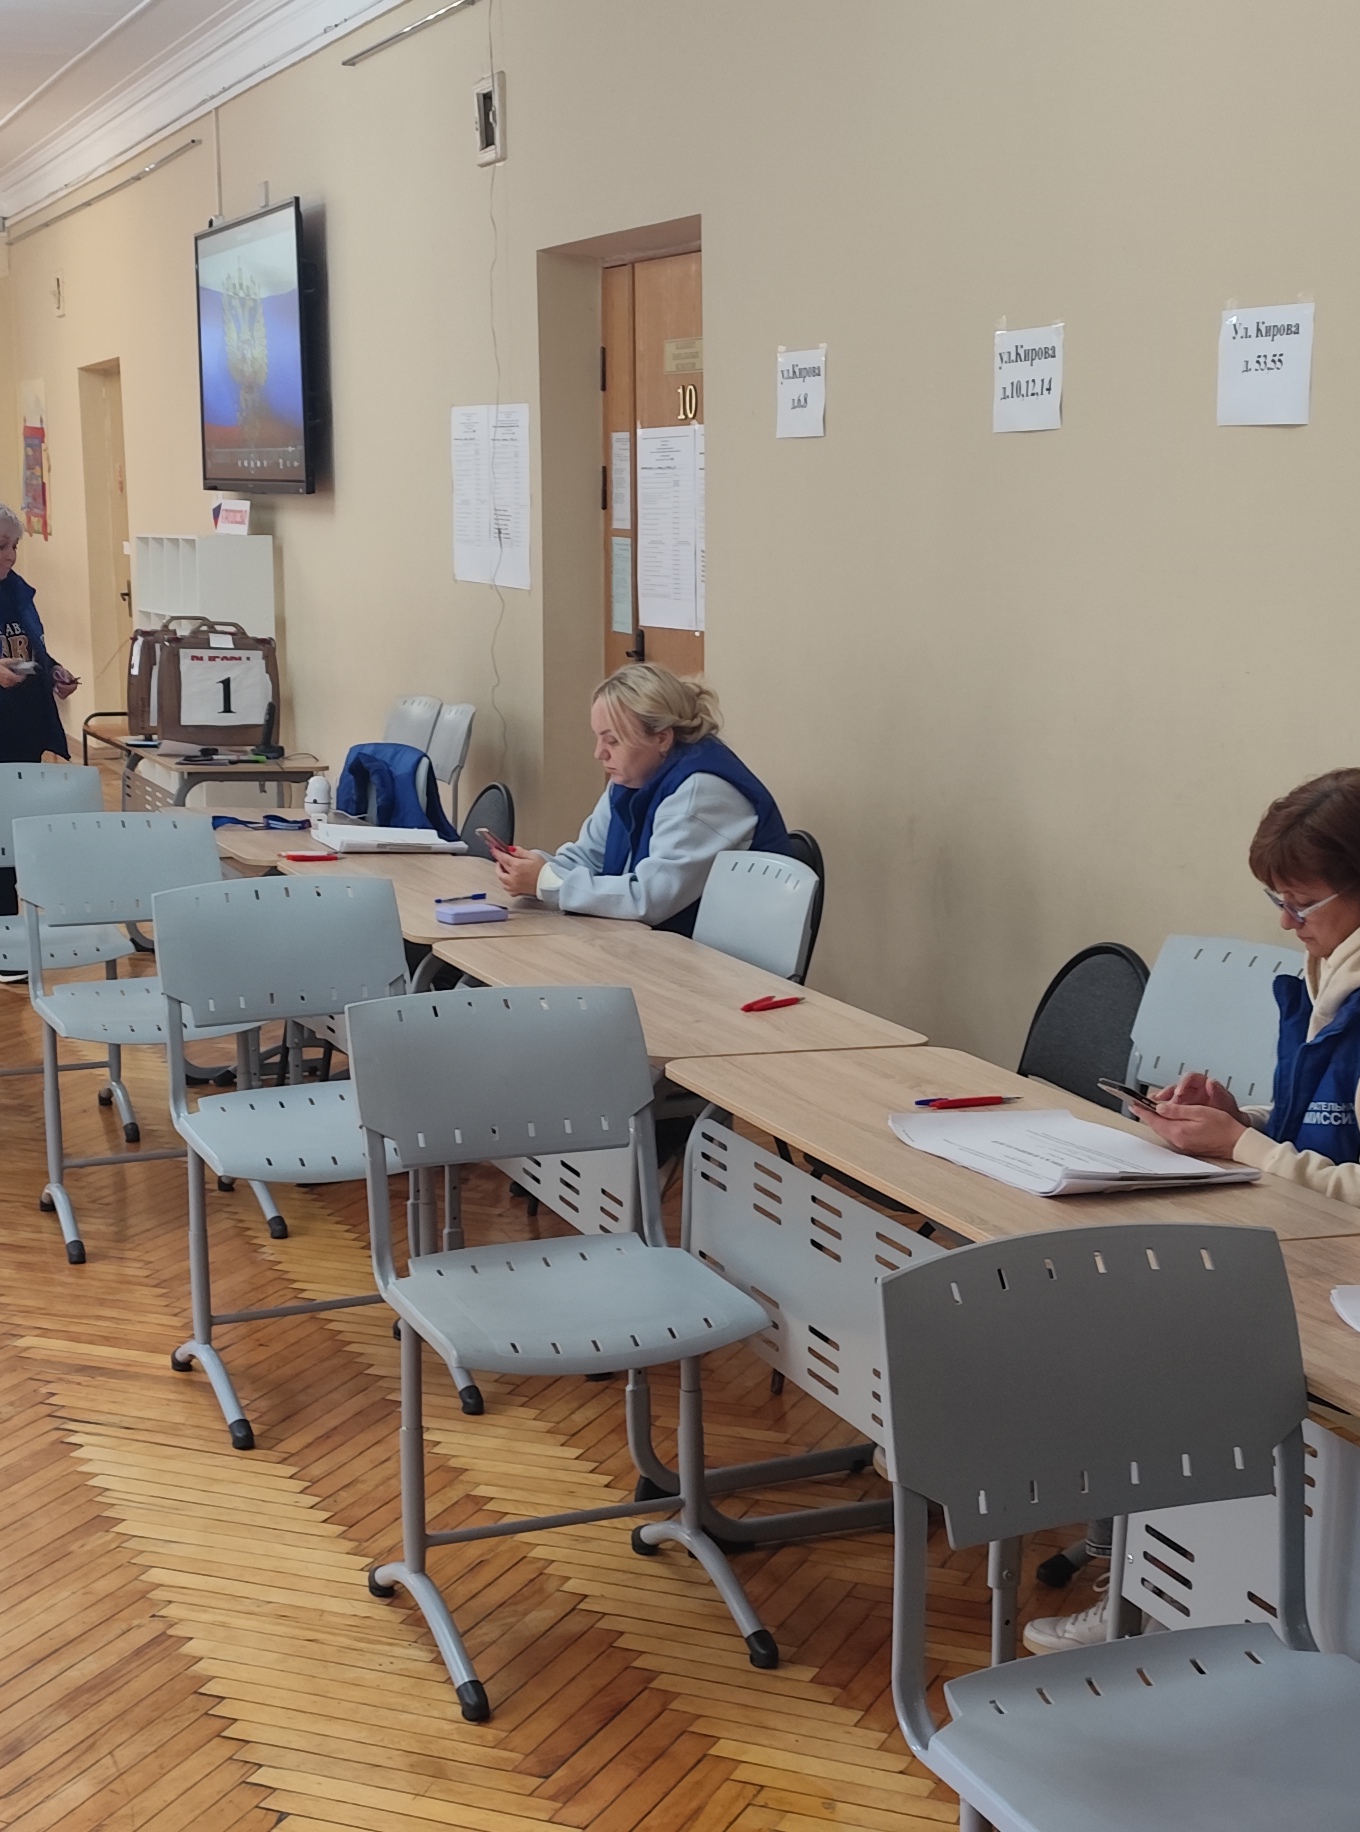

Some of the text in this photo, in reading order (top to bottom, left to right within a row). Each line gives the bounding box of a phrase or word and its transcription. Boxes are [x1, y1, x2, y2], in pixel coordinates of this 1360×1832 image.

[1231, 320, 1301, 342] Ул. Кирова
[998, 344, 1057, 371] ул.Кирова
[1241, 359, 1252, 374] д.
[999, 376, 1053, 401] д.10,12,14
[676, 384, 698, 420] 10
[215, 676, 238, 714] 1
